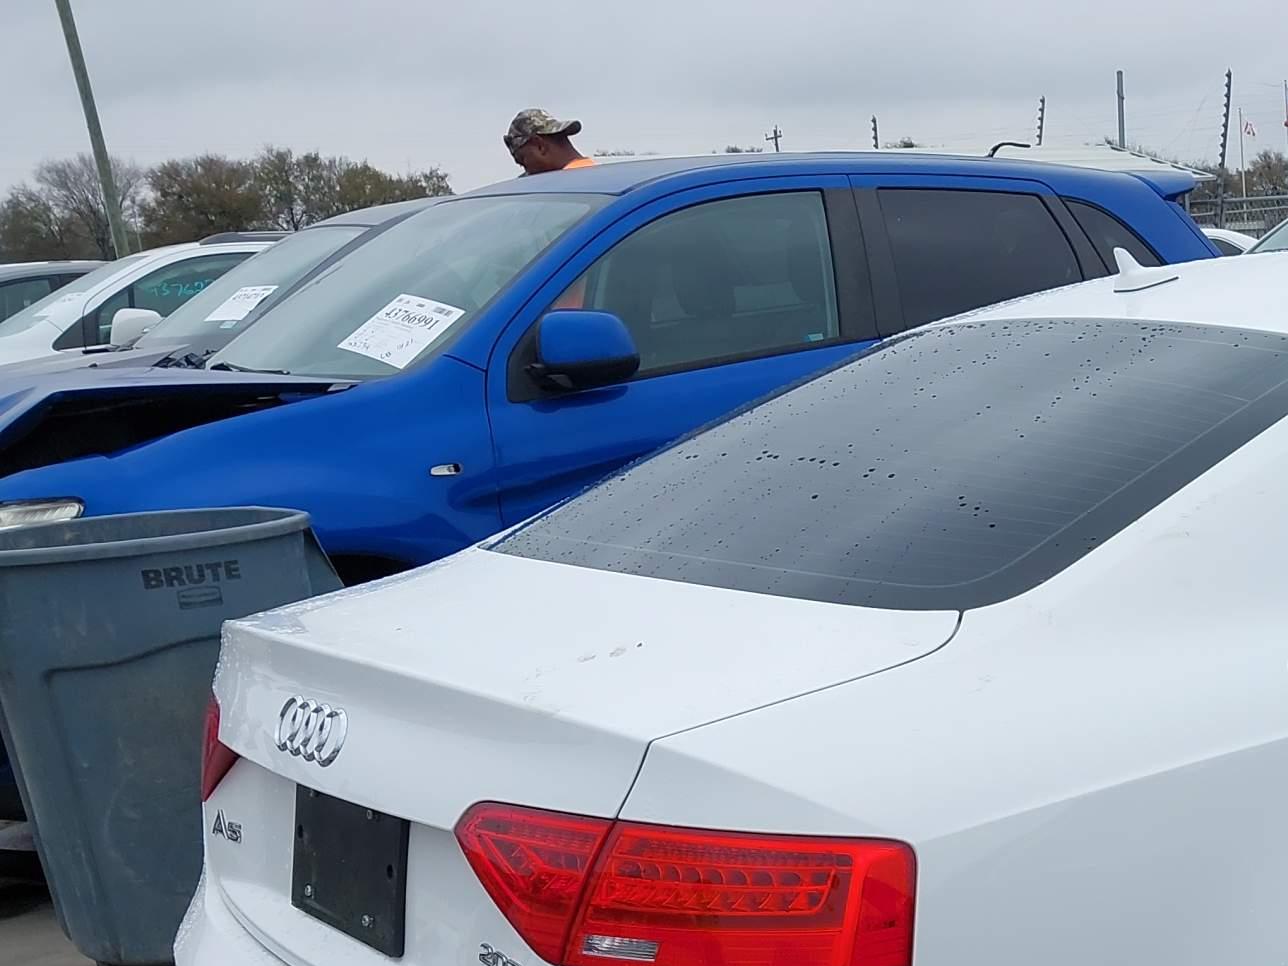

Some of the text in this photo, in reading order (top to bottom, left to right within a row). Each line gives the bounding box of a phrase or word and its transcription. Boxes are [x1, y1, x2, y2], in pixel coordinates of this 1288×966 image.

[384, 307, 440, 330] 43766991
[141, 559, 242, 590] BRUTE
[212, 808, 242, 844] A5
